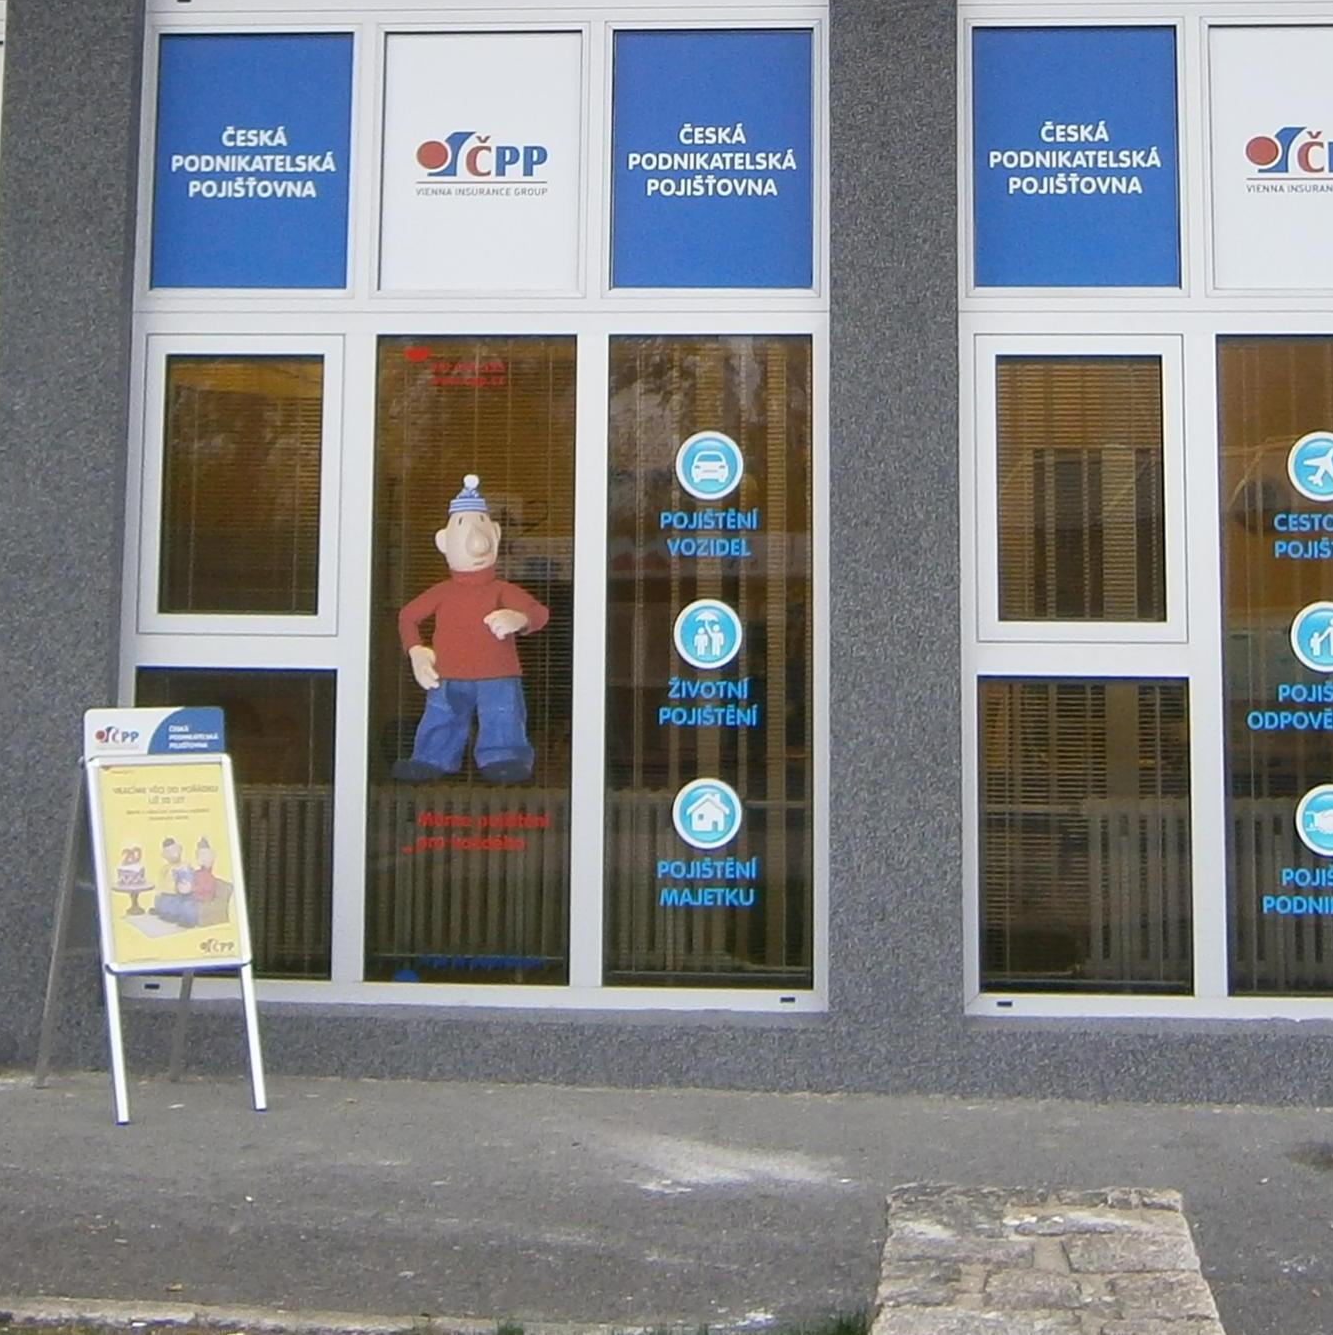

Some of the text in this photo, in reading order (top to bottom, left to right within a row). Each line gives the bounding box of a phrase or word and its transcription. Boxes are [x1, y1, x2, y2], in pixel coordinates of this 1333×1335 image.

[221, 125, 287, 147] ČESKÁ
[678, 123, 746, 145] ČESKÁ
[1041, 120, 1109, 142] ČESKÁ
[171, 150, 336, 173] PODNIKATELSKÁ
[465, 135, 548, 176] ČPP
[628, 148, 797, 171] PODNIKATELSKÁ
[989, 145, 1161, 168] PODNIKATELSKÁ
[188, 175, 316, 198] POJIŠŤOVNA
[416, 187, 548, 196] VIENNA INSURANCE GROUP
[646, 174, 778, 197] POJIŠŤOVNA
[1008, 172, 1143, 195] POJIŠŤOVNA
[1247, 184, 1284, 193] VIENNA
[660, 509, 758, 529] POJIŠTĚNÍ
[667, 539, 751, 556] VOZIDEL
[668, 677, 749, 698] ŽIVOTNÍ
[659, 705, 758, 726] POJIŠTĚNÍ
[657, 857, 757, 879] POJIŠTĚNÍ
[660, 889, 755, 906] MAJETKU
